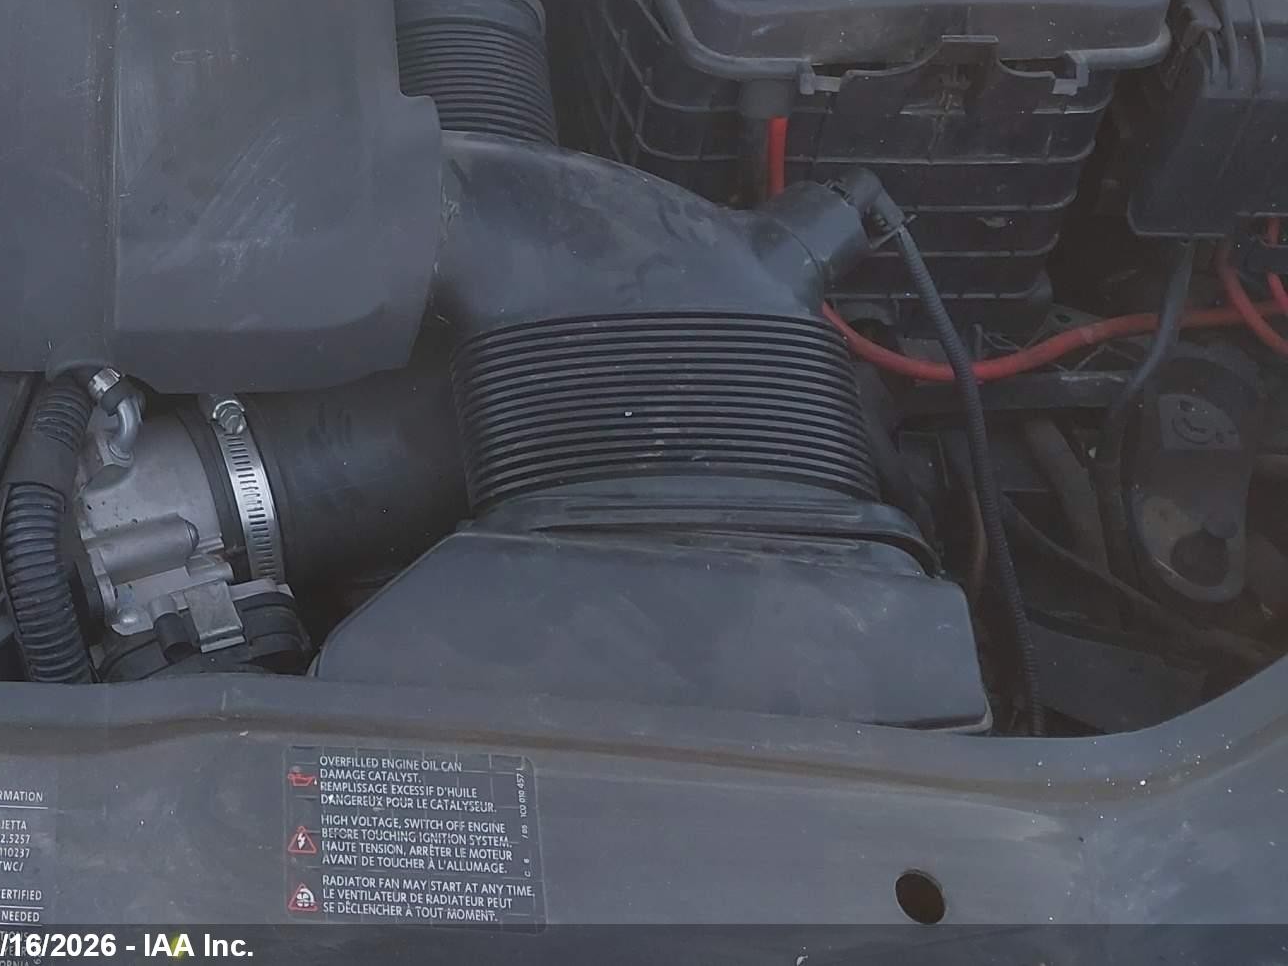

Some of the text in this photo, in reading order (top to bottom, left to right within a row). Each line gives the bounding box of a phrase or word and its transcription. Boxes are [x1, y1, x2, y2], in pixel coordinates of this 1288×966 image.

[320, 756, 462, 772] OVERFILLED ENGINE OIL CAN
[320, 768, 422, 783] DAMAGE CATALYST.
[320, 782, 478, 798] REMPLISSAGE EXCESSIF D'HUILE
[321, 794, 497, 812] DANGEREUX POUR LE CATALYSEUR.
[320, 814, 506, 834] HIGH VOLTAGE, SWITCH OFF ENGINE
[322, 828, 512, 848] BEFORE TOUCHING IGNITION SYSTEM.
[322, 840, 512, 861] HAUTE TENSION, ARRÊTER LE MOTEUR
[322, 854, 358, 866] AVANT
[362, 856, 375, 867] DE
[377, 856, 424, 869] TOUCHER
[438, 860, 508, 874] L'ALLUMAGE.
[322, 874, 536, 897] RADIATOR FAN MAY START AT ANY TIME.
[323, 889, 512, 909] LE VENTILATEUR DE RADIATEUR PEUT
[2, 910, 40, 922] NEEDED
[323, 902, 335, 913] SE
[415, 906, 444, 920] TOUT
[447, 908, 498, 922] MOMENT.
